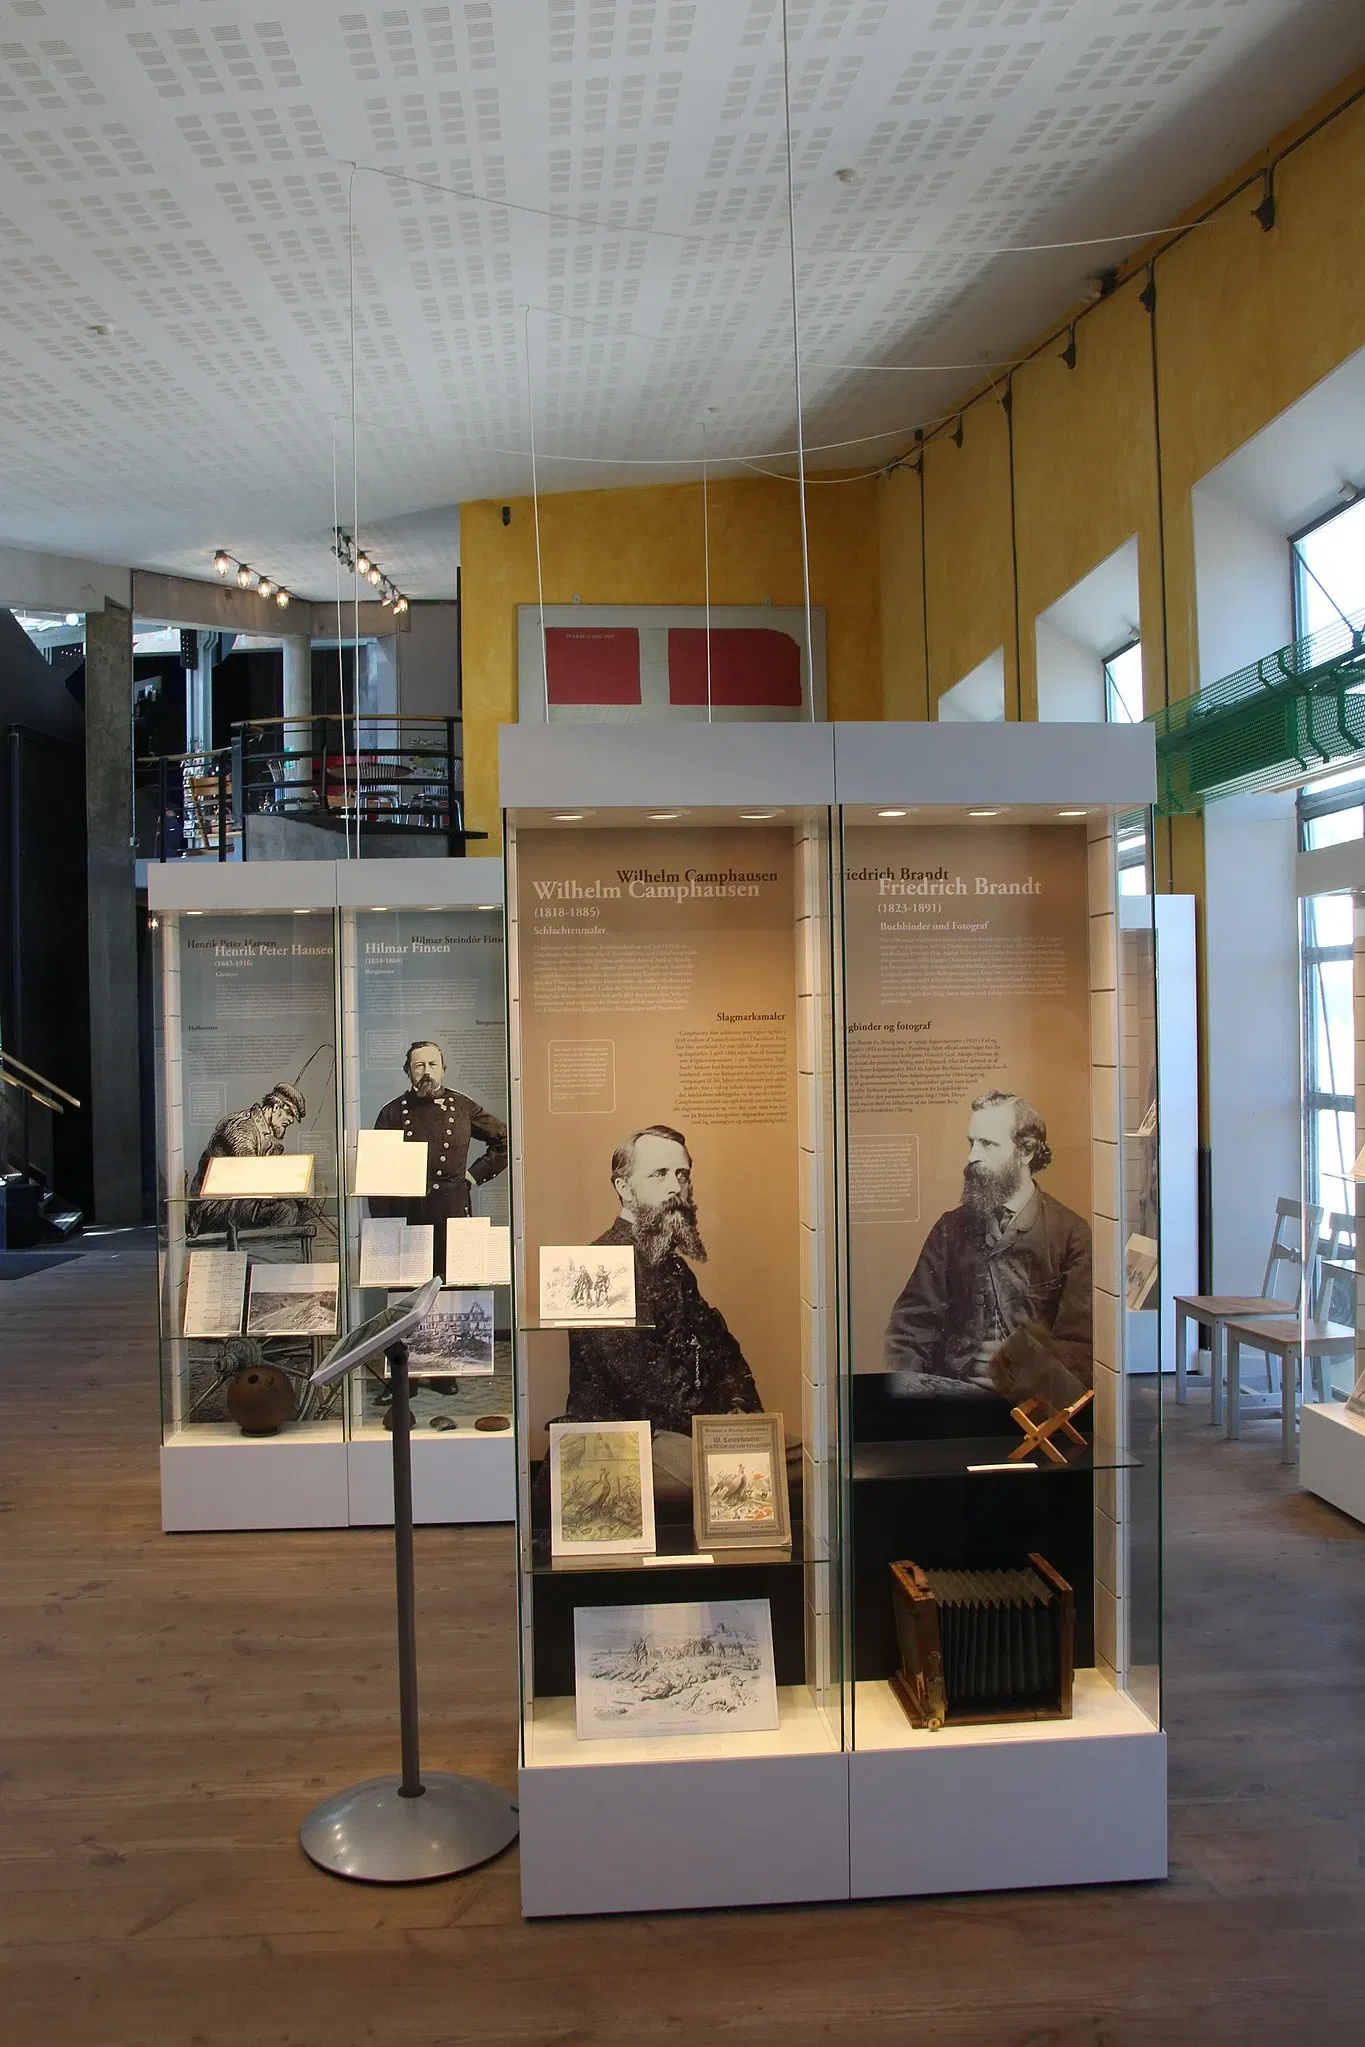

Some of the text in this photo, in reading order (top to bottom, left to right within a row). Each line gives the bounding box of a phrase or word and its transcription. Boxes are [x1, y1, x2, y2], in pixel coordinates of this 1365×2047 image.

[616, 868, 778, 887] Wilhelm Camphausen
[844, 867, 949, 881] iedrich Brandt
[532, 879, 761, 904] Wilhelm Camphausen
[878, 877, 1042, 897] Friedrich Brandt
[534, 906, 601, 918] (1818-1885)
[878, 903, 942, 914] (1823-1891)
[533, 926, 607, 936] Schlachtenmaler
[880, 920, 989, 932] Buchbinder und Fotograf
[187, 939, 277, 949] Henrik Peter Hansen
[411, 935, 442, 944] Hilmar
[214, 944, 333, 957] Henrik Peter Hansen
[365, 942, 451, 954] Hilmar Finsen
[716, 1011, 786, 1024] Slagmarksmaler
[884, 1024, 895, 1033] og
[896, 1020, 932, 1033] fotograf
